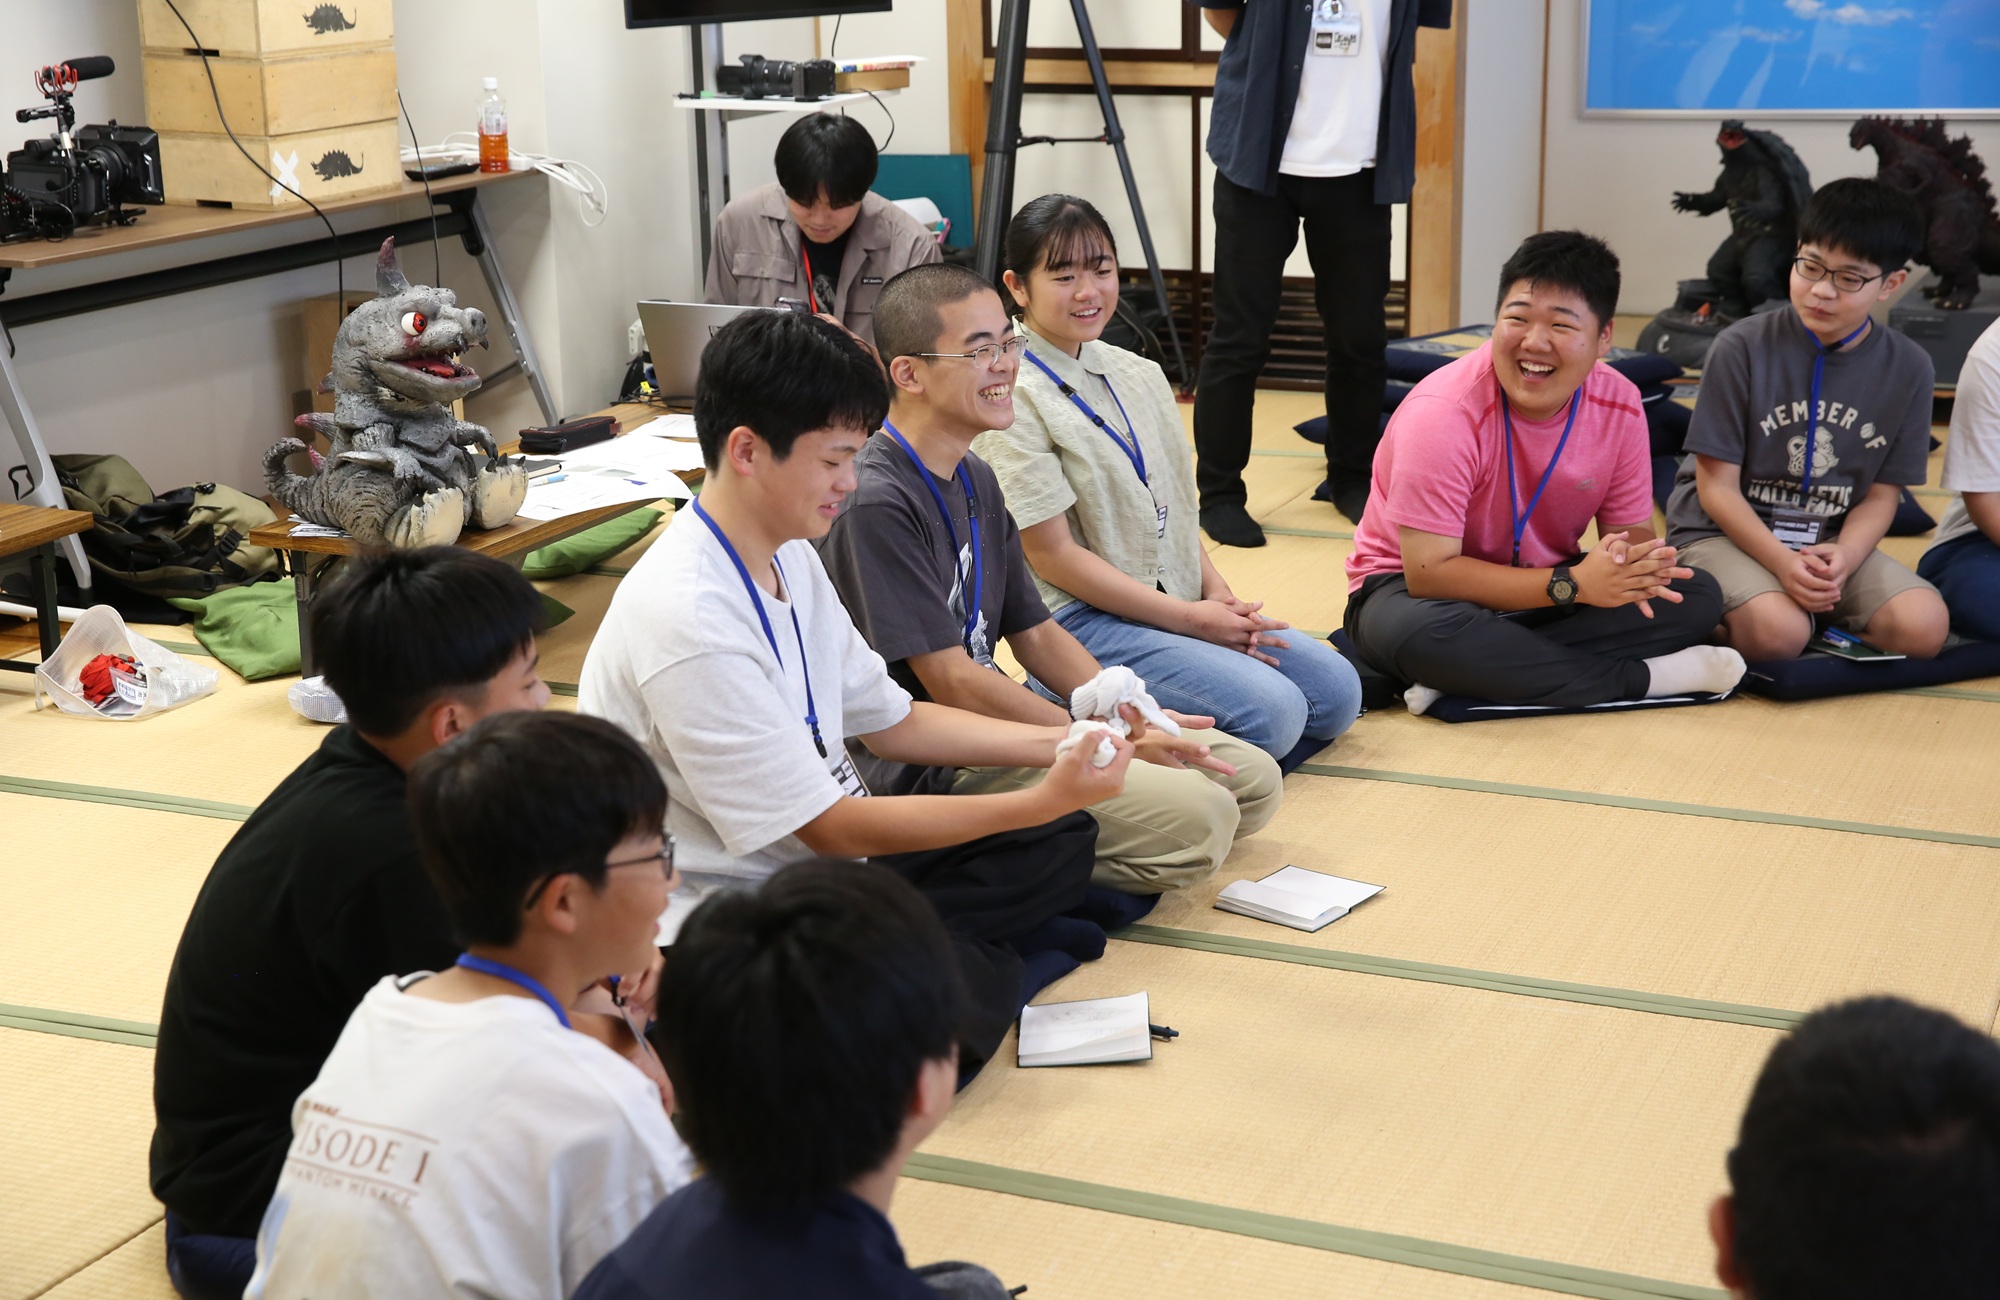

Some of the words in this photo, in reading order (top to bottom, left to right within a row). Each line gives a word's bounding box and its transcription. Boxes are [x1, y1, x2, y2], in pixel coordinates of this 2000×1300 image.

[1760, 400, 1858, 437] MEMBER
[1805, 496, 1847, 517] FAM
[413, 1151, 430, 1183] I
